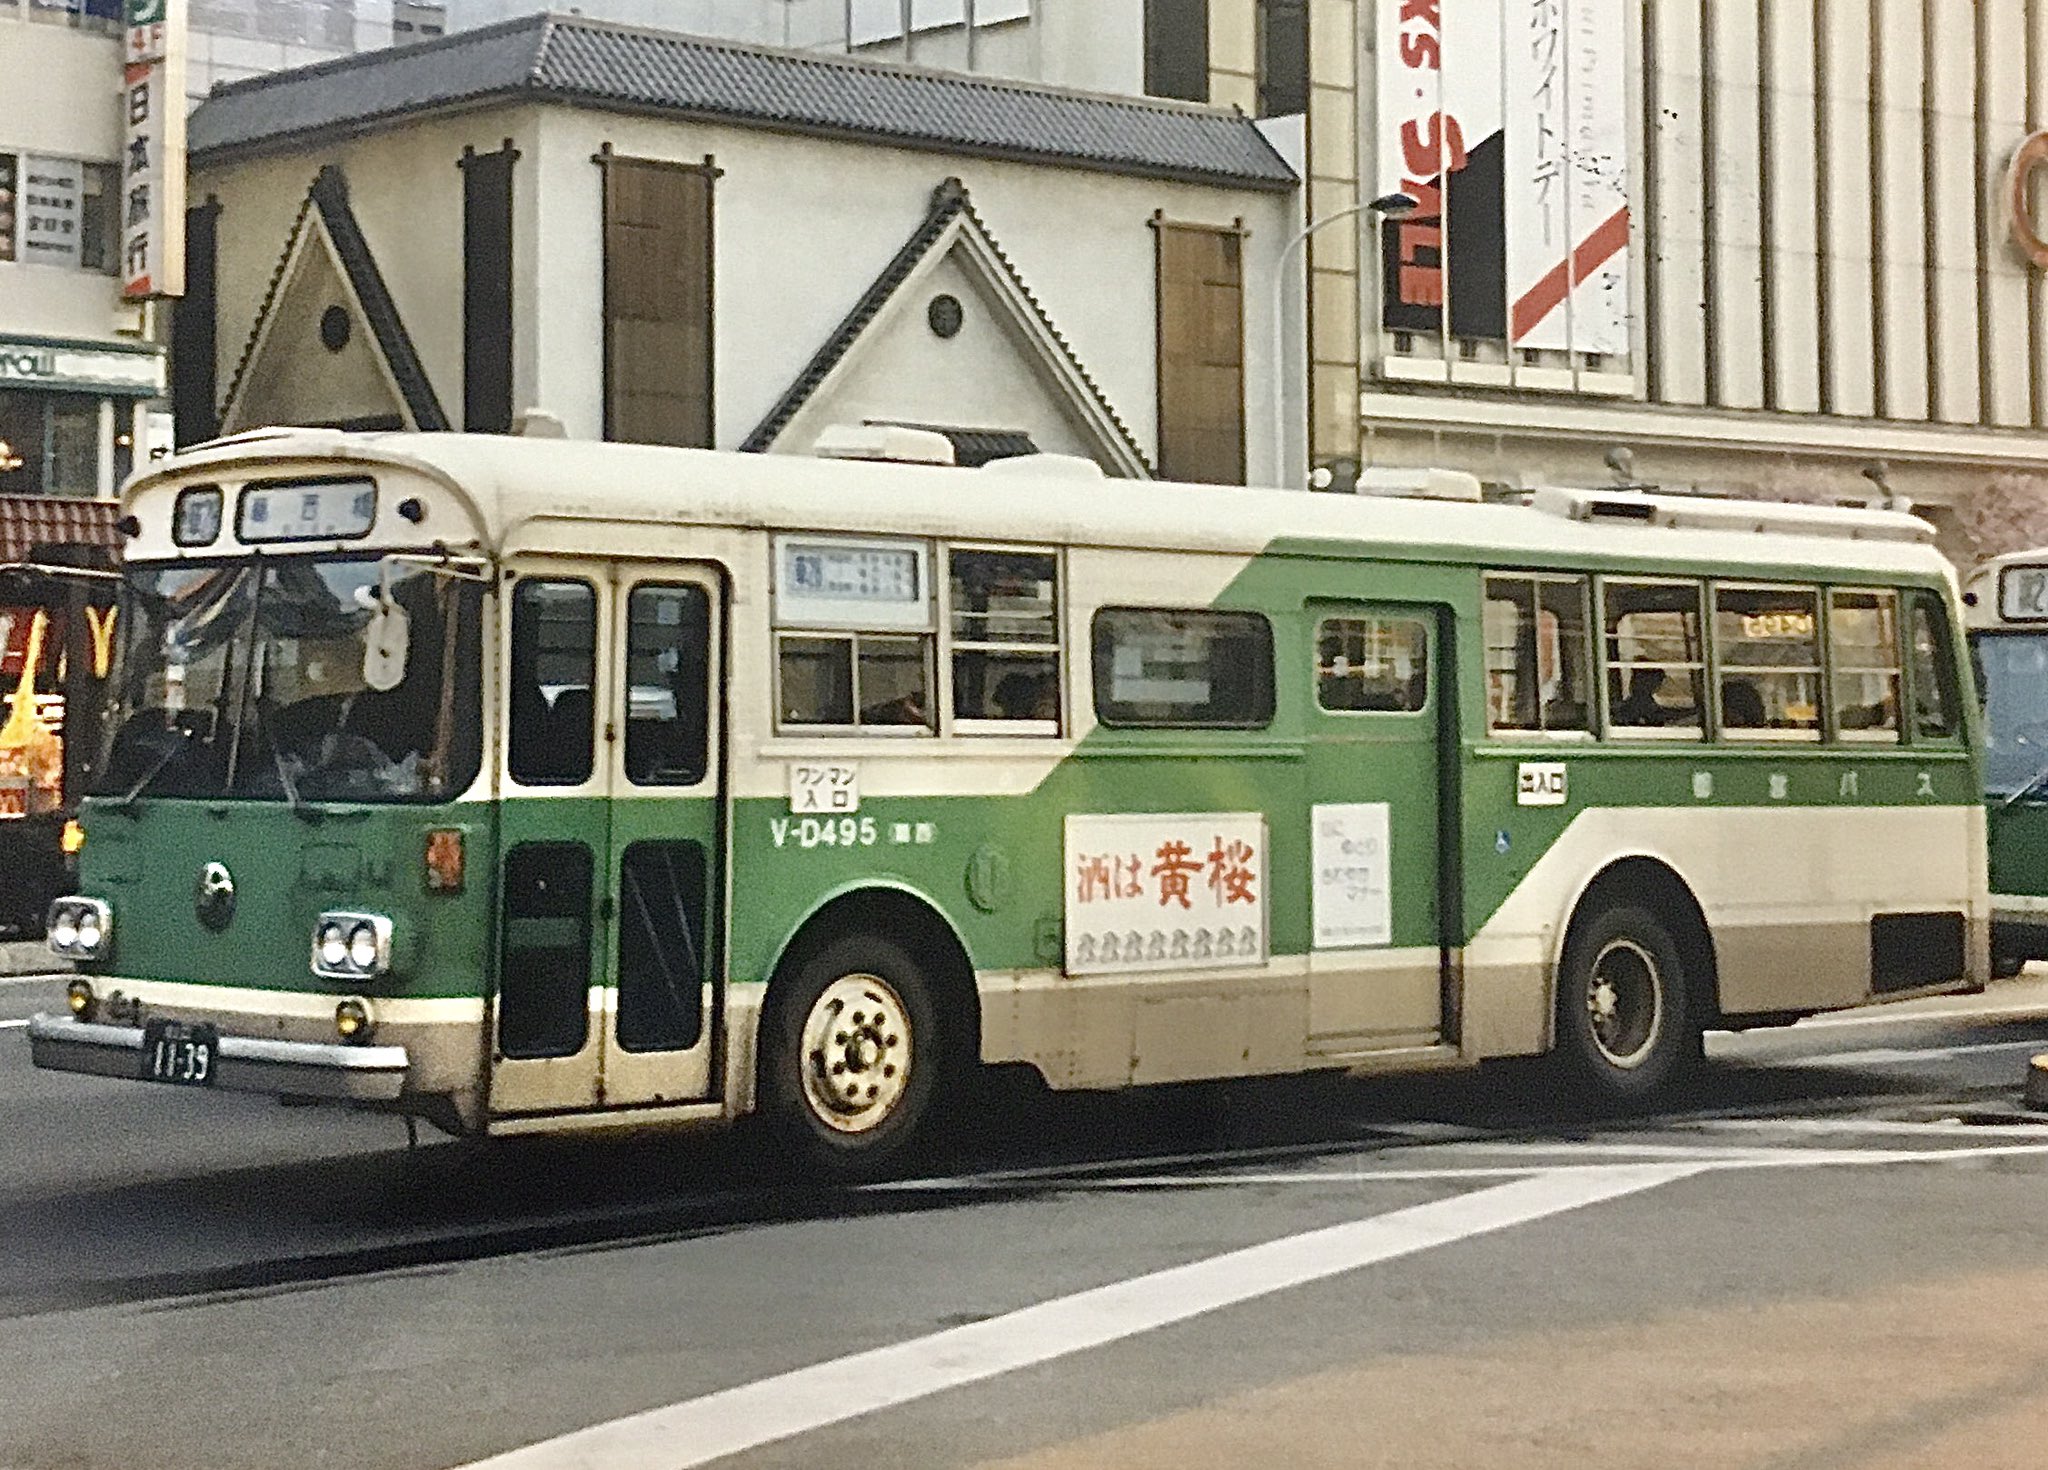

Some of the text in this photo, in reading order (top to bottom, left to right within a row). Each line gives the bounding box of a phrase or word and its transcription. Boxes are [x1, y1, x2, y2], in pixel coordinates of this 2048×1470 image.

[796, 767, 856, 786] ワンマン
[803, 789, 849, 808] 入口
[770, 816, 878, 848] V-D495
